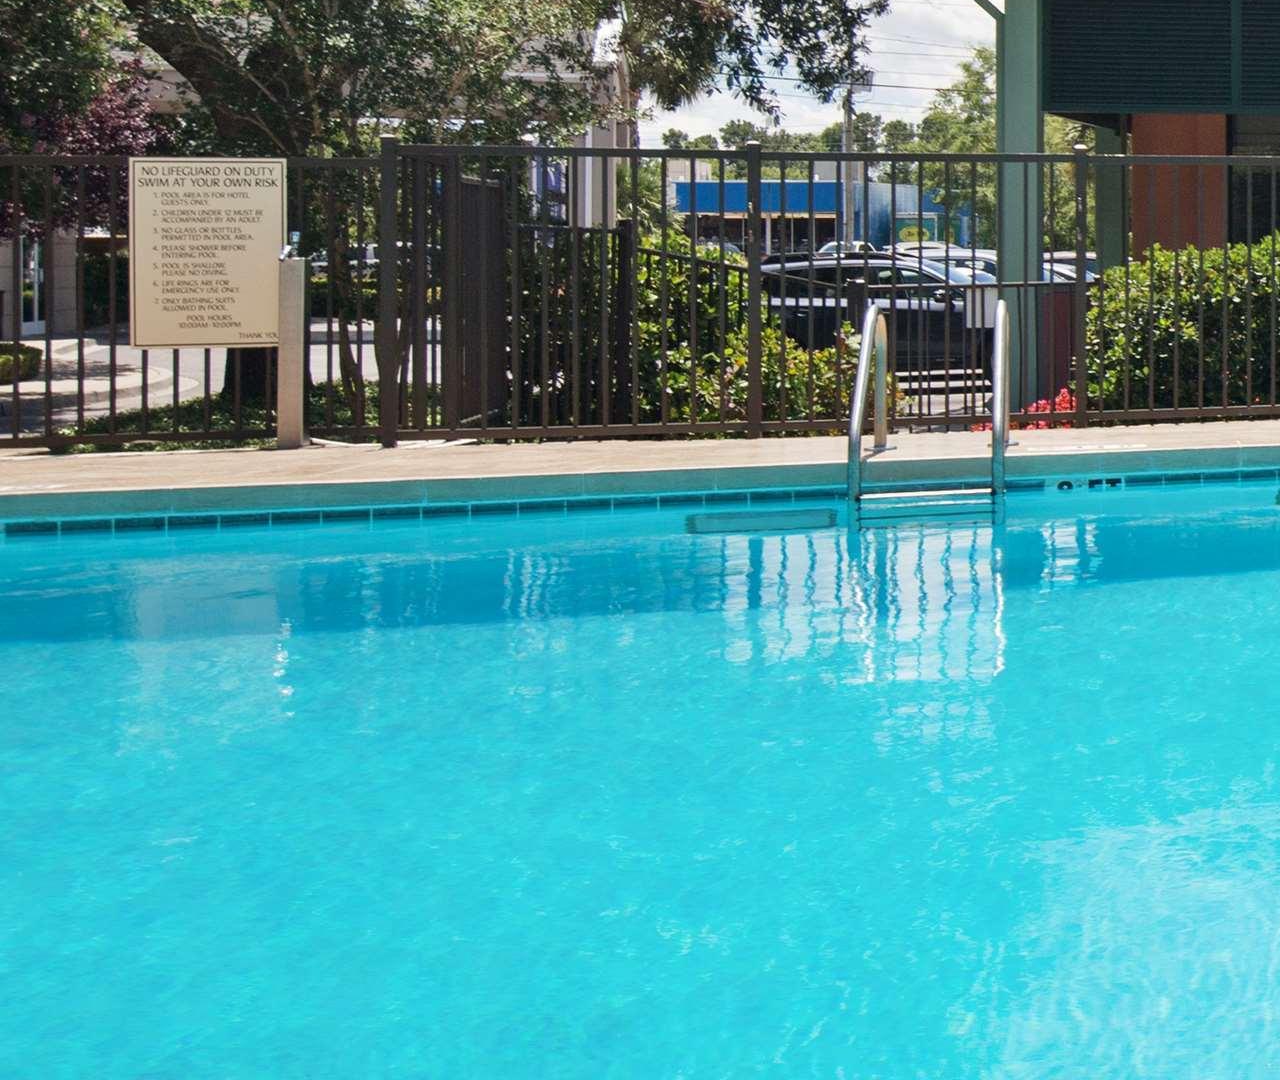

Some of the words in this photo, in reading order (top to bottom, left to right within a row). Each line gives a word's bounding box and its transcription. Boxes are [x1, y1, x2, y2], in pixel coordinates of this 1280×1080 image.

[142, 167, 158, 176] NO
[162, 167, 220, 176] LIFEGUARD
[224, 167, 240, 176] ON
[244, 167, 274, 176] DUTY
[138, 178, 169, 187] SWIM
[172, 178, 185, 187] AT
[191, 178, 220, 187] YOUR
[224, 178, 251, 187] OWN
[255, 178, 279, 187] RISK
